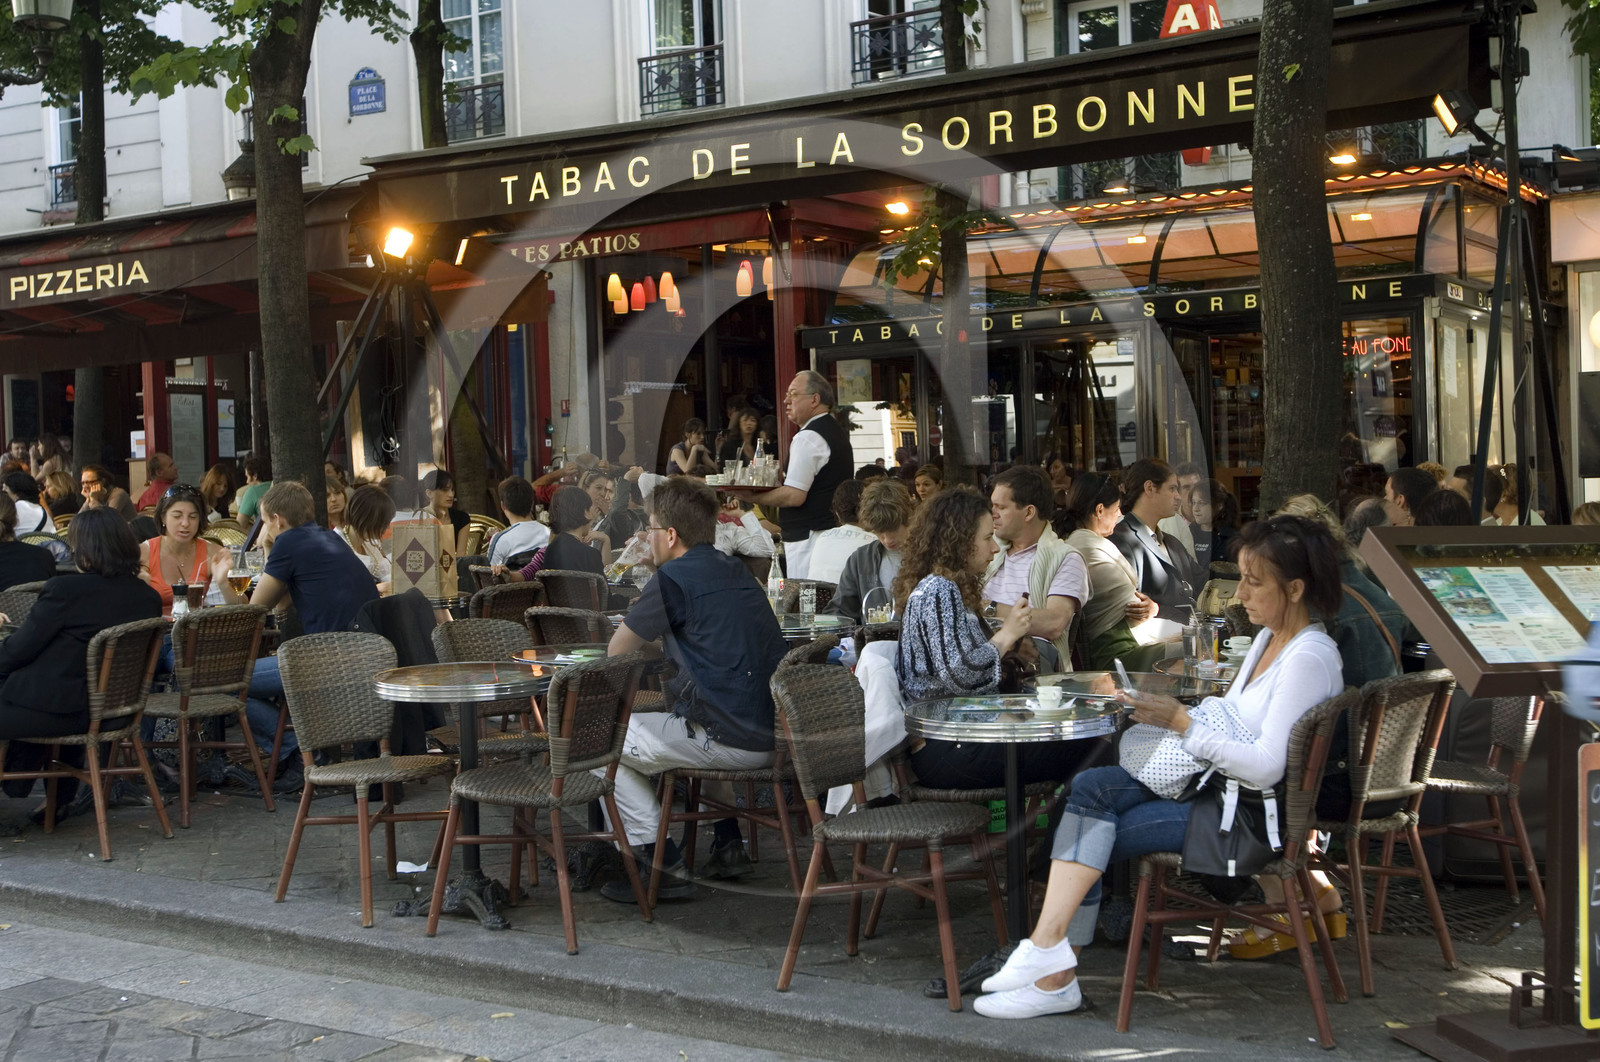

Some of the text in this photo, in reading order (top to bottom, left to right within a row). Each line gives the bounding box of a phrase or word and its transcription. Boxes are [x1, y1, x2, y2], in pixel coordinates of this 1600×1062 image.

[357, 85, 377, 95] PLACE
[359, 94, 376, 103] DE LA
[352, 101, 383, 112] SORBONNE
[500, 74, 1255, 206] TABAC DE LA SORBONNE
[559, 233, 641, 260] PATIOS
[9, 260, 149, 301] PIZZERIA
[981, 313, 1024, 332] DE
[1060, 307, 1103, 326] LA
[1143, 281, 1404, 319] SORBNE
[1351, 339, 1368, 356] AU
